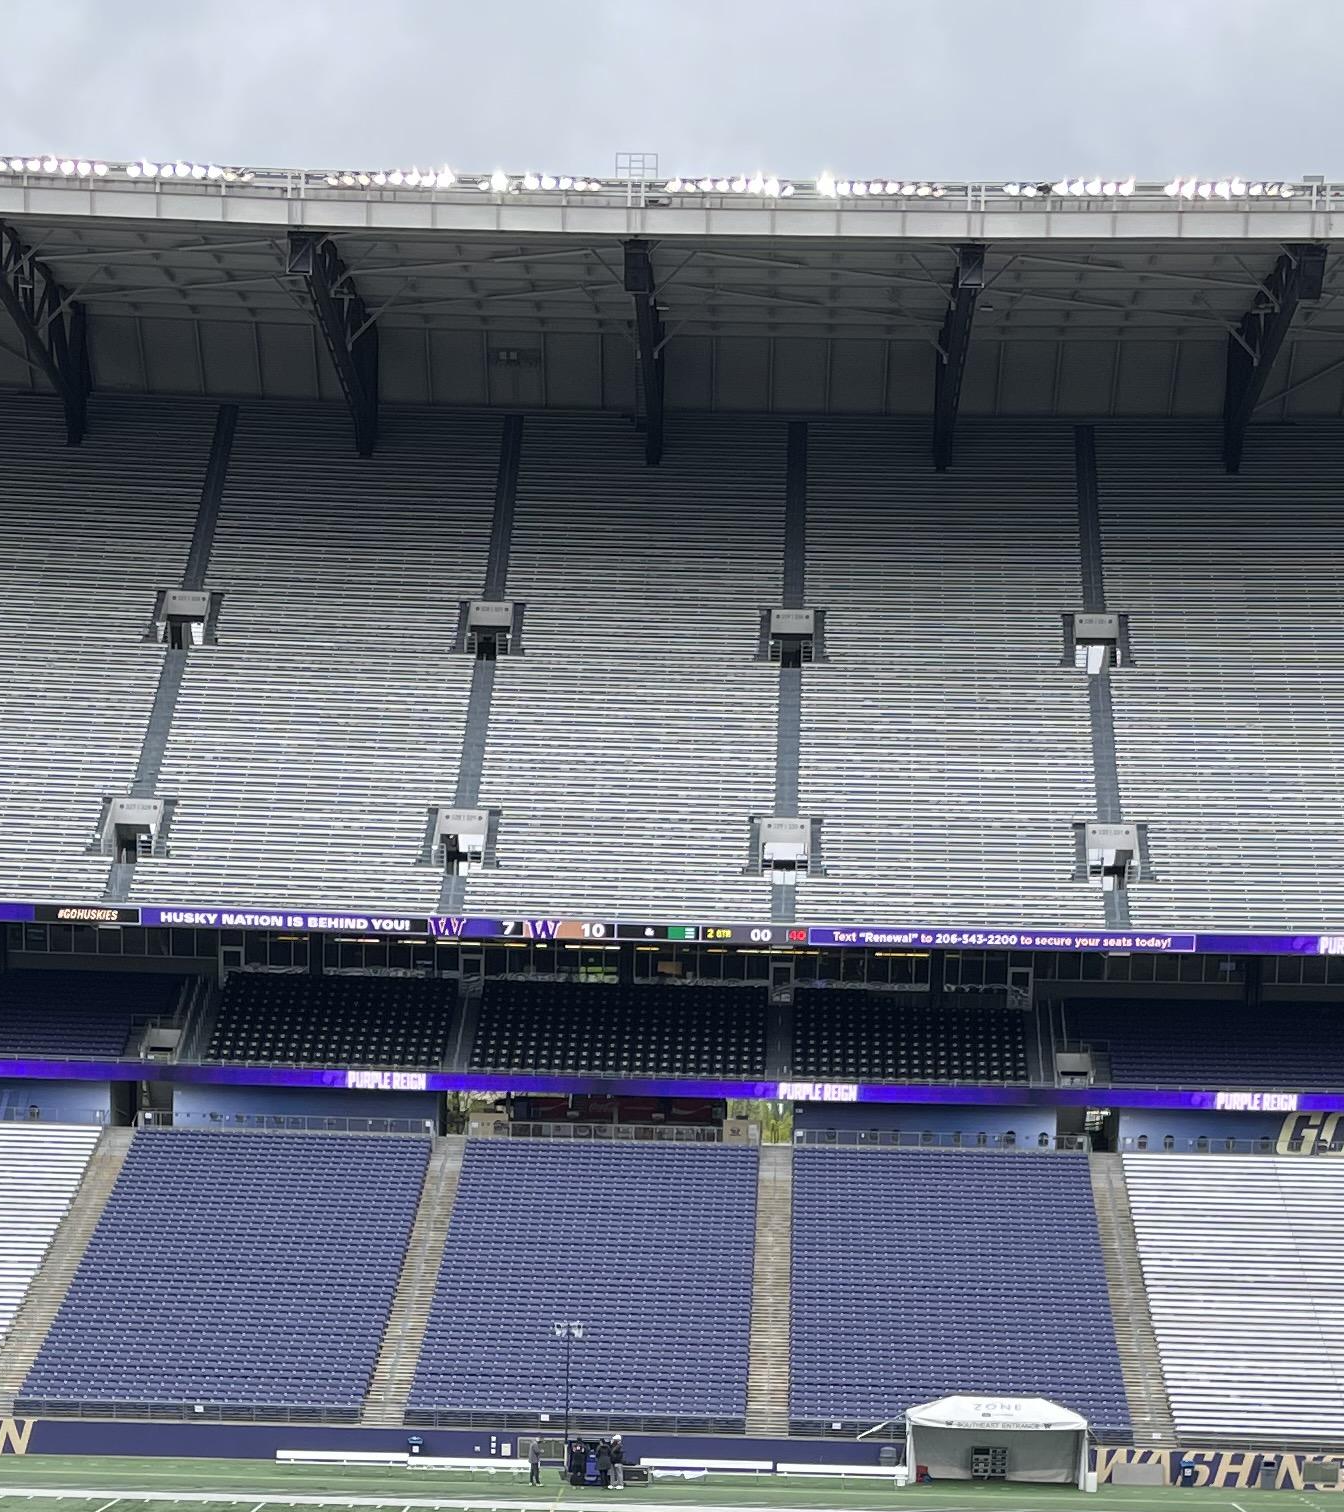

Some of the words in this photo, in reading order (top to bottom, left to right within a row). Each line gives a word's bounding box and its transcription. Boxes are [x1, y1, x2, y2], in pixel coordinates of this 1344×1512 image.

[57, 908, 119, 921] #GOHUSKIES
[160, 911, 218, 924] HUSKY
[222, 914, 283, 926] NATION
[287, 916, 304, 927] IS
[308, 917, 368, 929] BEHIND
[371, 919, 411, 930] YOU!
[502, 921, 515, 935] 7
[581, 923, 605, 937] 10
[706, 928, 715, 938] 2
[750, 929, 772, 942] 00
[833, 931, 856, 942] Text
[921, 934, 933, 943] to
[936, 934, 1018, 945] 206-543-2200
[1021, 935, 1033, 945] to
[1035, 937, 1072, 946] secure
[1075, 938, 1100, 948] your
[1103, 937, 1133, 947] seats
[1135, 937, 1171, 948] today!
[347, 1071, 391, 1089] PURPLE
[392, 1072, 427, 1090] REIGN
[778, 1082, 822, 1100] PURPLE
[823, 1083, 858, 1101] REIGN
[1215, 1092, 1261, 1110] PURPLE
[1262, 1093, 1298, 1110] REIGN
